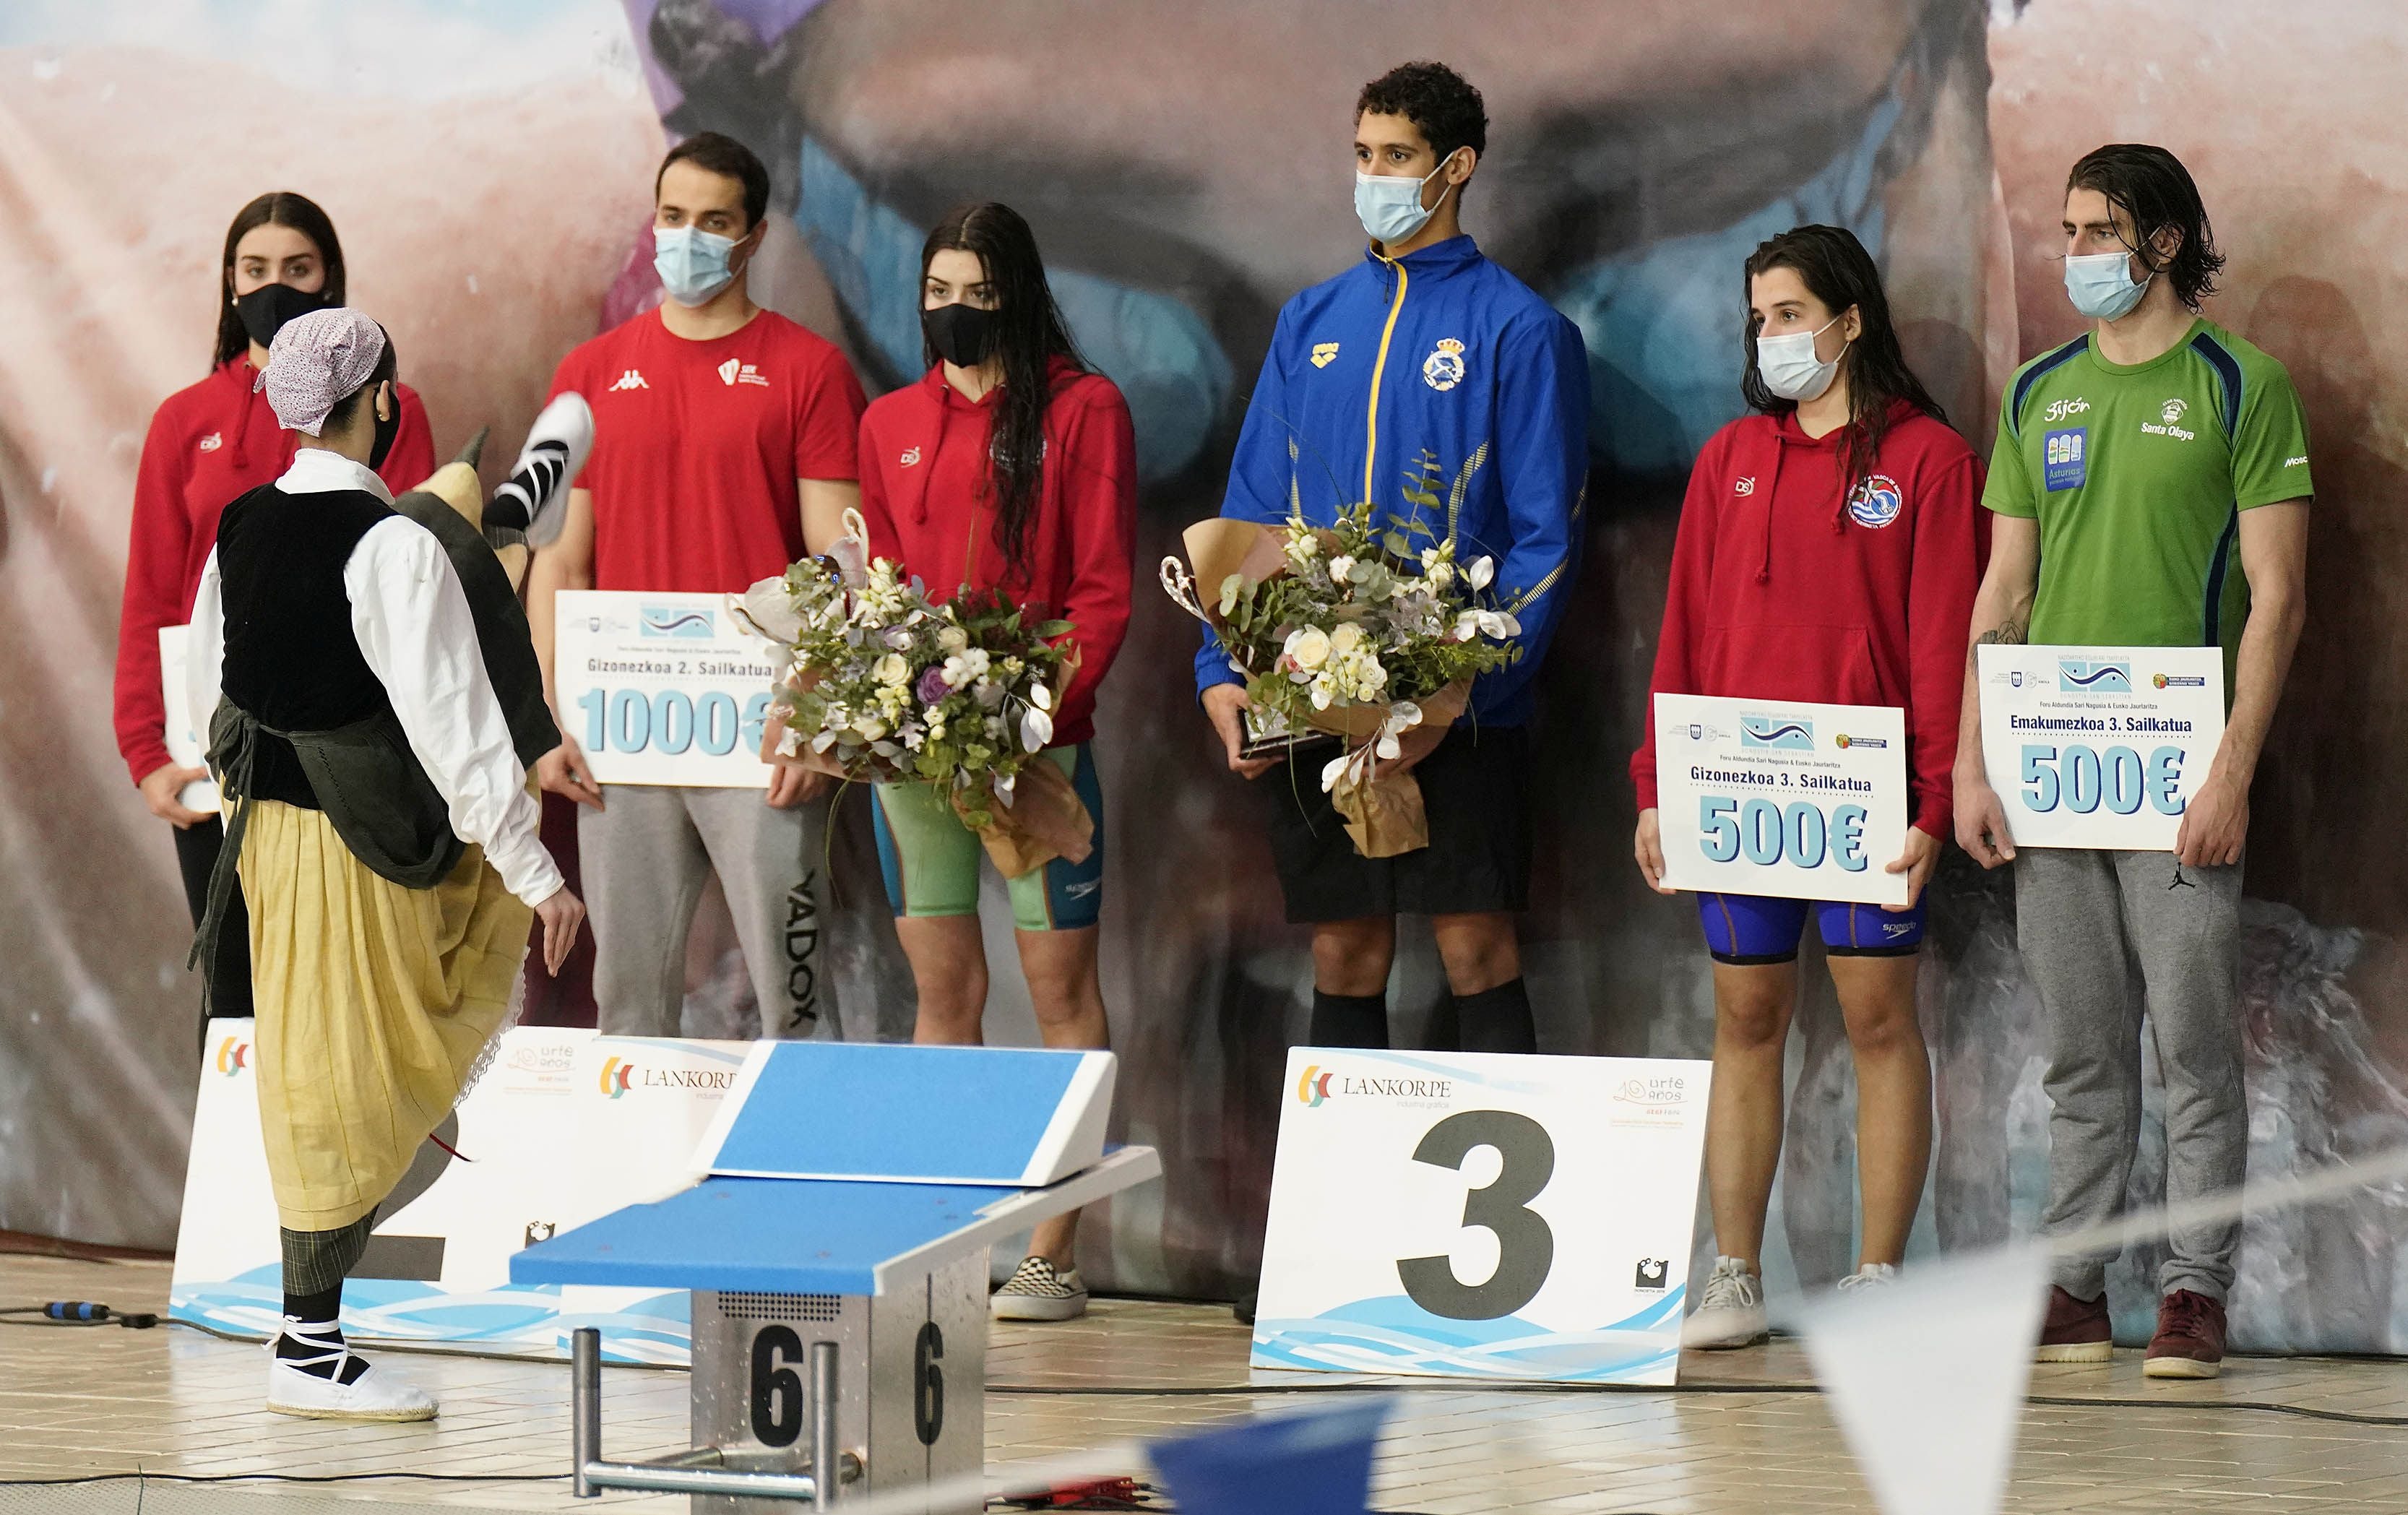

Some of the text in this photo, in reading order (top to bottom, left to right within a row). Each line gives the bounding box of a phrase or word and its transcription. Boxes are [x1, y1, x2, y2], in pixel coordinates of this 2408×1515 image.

[2141, 422, 2194, 441] Santa Olaya
[2049, 468, 2081, 479] Asturias
[588, 658, 772, 677] Gizonezkoa 2. Sailkatua
[2011, 715, 2192, 733] Emakumezkoa 3. Sailkatua
[1691, 766, 1872, 792] Gizonezkoa 3. Sailkatua
[2021, 744, 2185, 816] 500€
[1699, 795, 1868, 873] 500€
[1342, 1077, 1451, 1098] LANKORPE
[1649, 1076, 1684, 1089] urte
[1397, 1110, 1555, 1321] 3
[750, 1320, 944, 1446] 6 6
